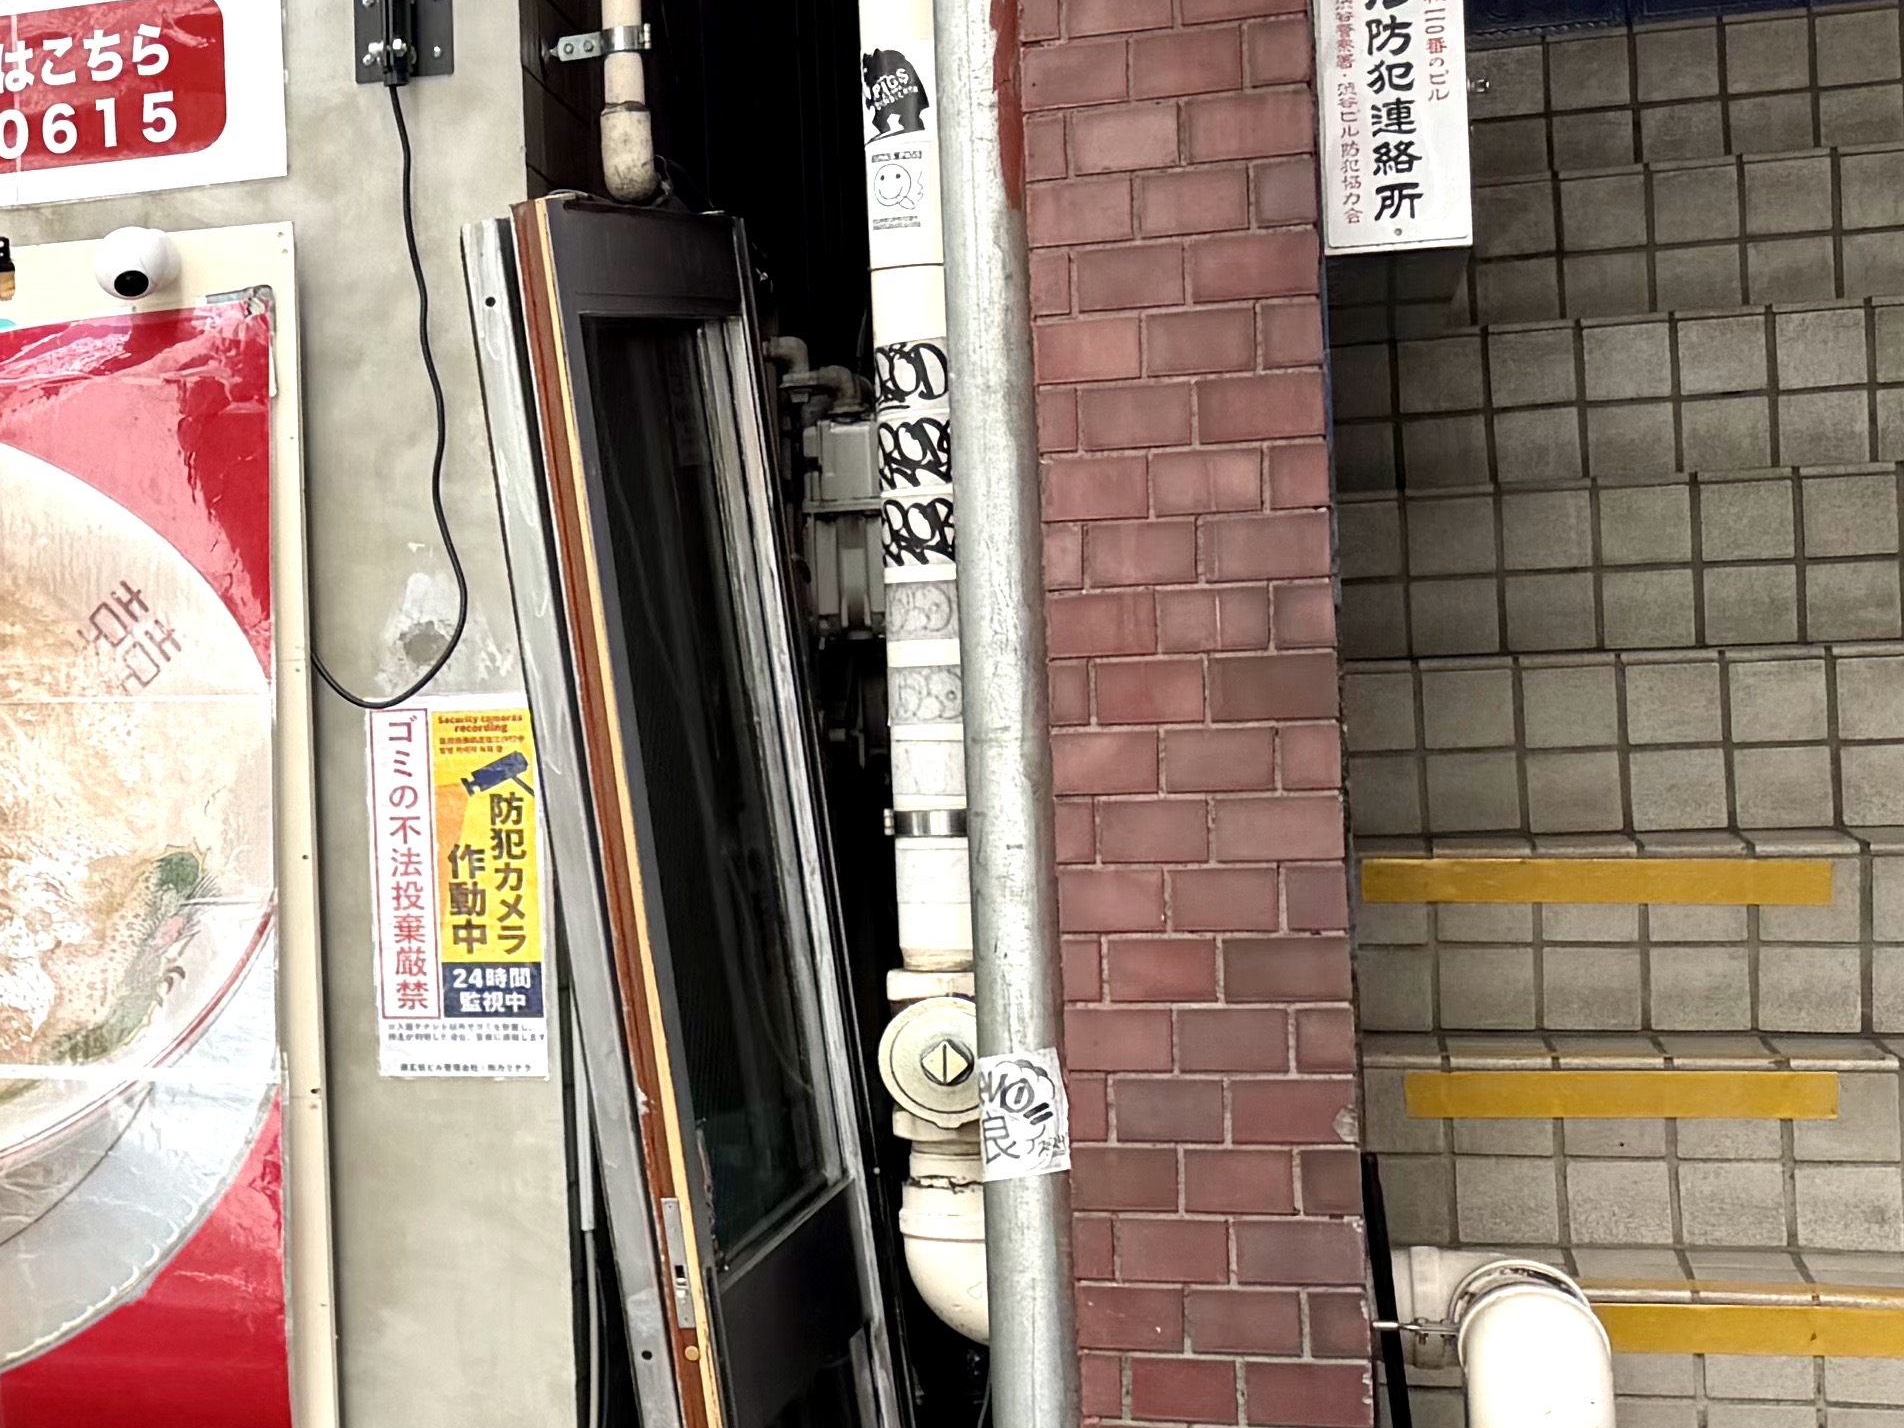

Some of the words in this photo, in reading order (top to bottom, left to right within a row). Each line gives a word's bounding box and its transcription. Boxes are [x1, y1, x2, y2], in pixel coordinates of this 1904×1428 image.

[386, 716, 431, 1011] ゴミの不法投棄厳禁
[448, 844, 488, 955] 作動中
[489, 793, 528, 956] 防犯カメラ
[453, 967, 532, 989] 24時間
[459, 991, 527, 1013] 監視中
